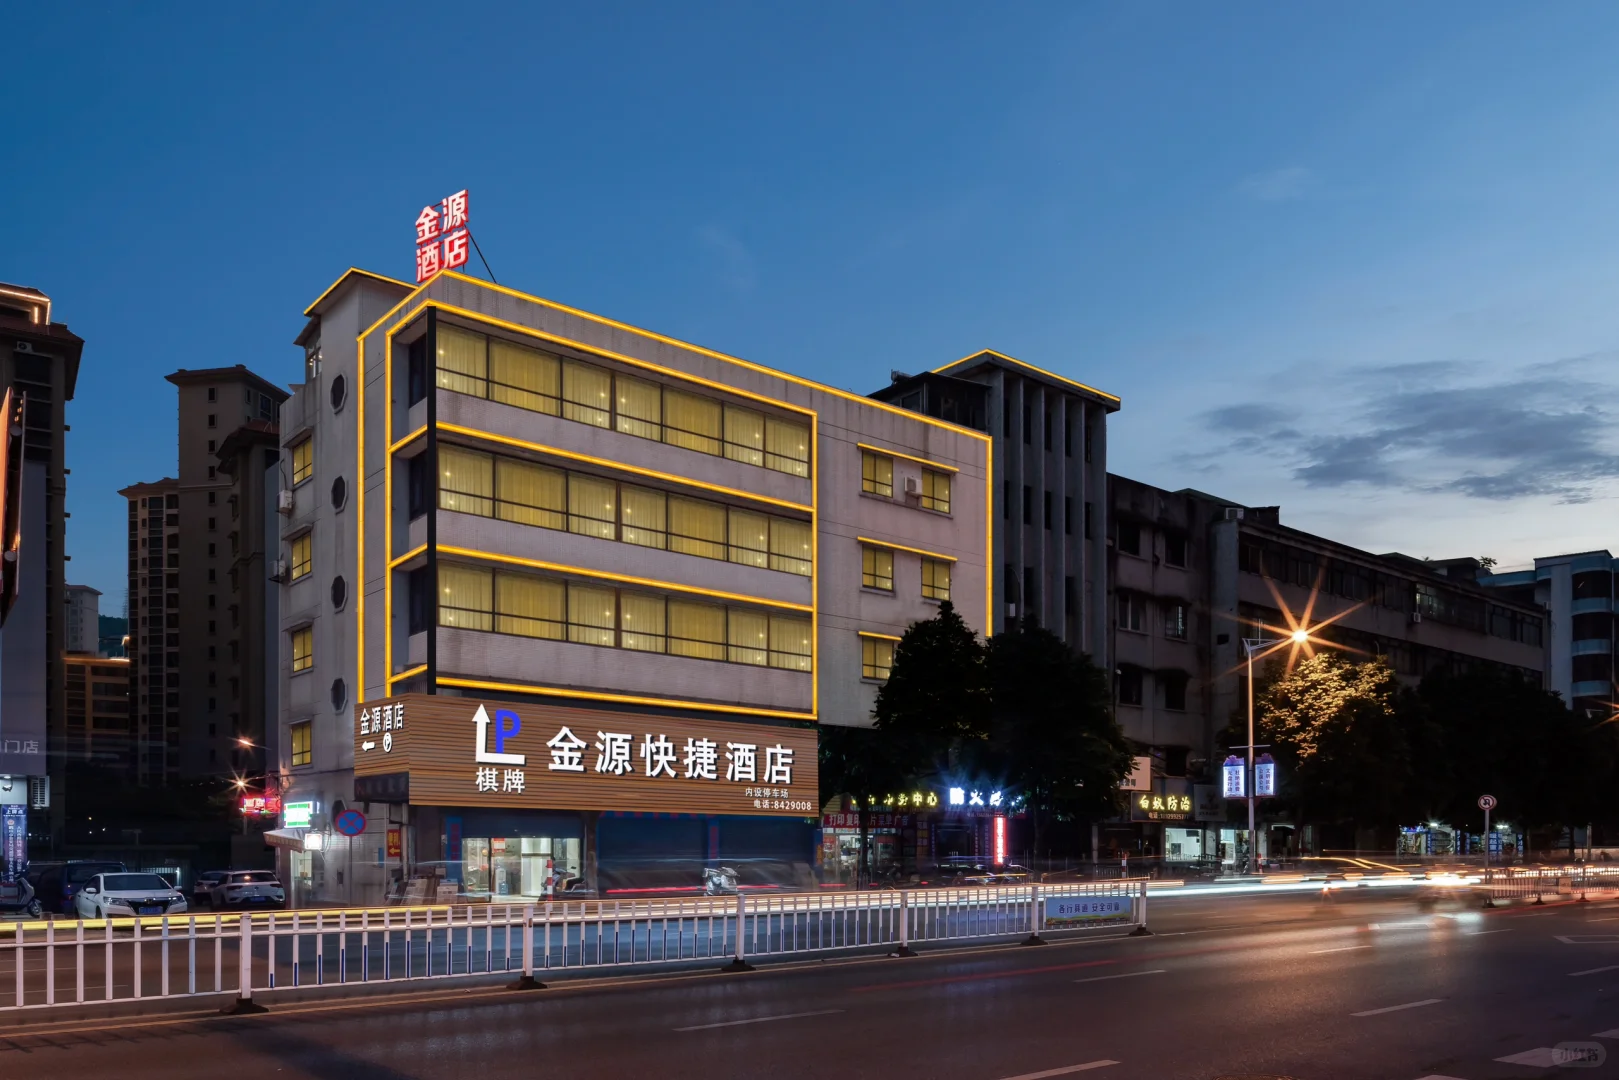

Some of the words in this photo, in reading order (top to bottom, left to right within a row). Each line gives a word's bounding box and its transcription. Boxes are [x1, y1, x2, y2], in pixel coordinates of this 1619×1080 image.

[415, 189, 469, 245] 金源
[416, 229, 469, 283] 酒店
[360, 701, 405, 735] 金源酒店
[495, 709, 521, 753] P
[546, 725, 795, 784] 金源快捷酒店
[476, 767, 526, 794] 棋牌
[745, 787, 789, 799] 内设停车场
[754, 799, 812, 811] 电话:8429008
[1139, 795, 1191, 811] 白蚁防治
[1059, 903, 1089, 914] 各行其道
[1091, 902, 1120, 912] 安全可靠
